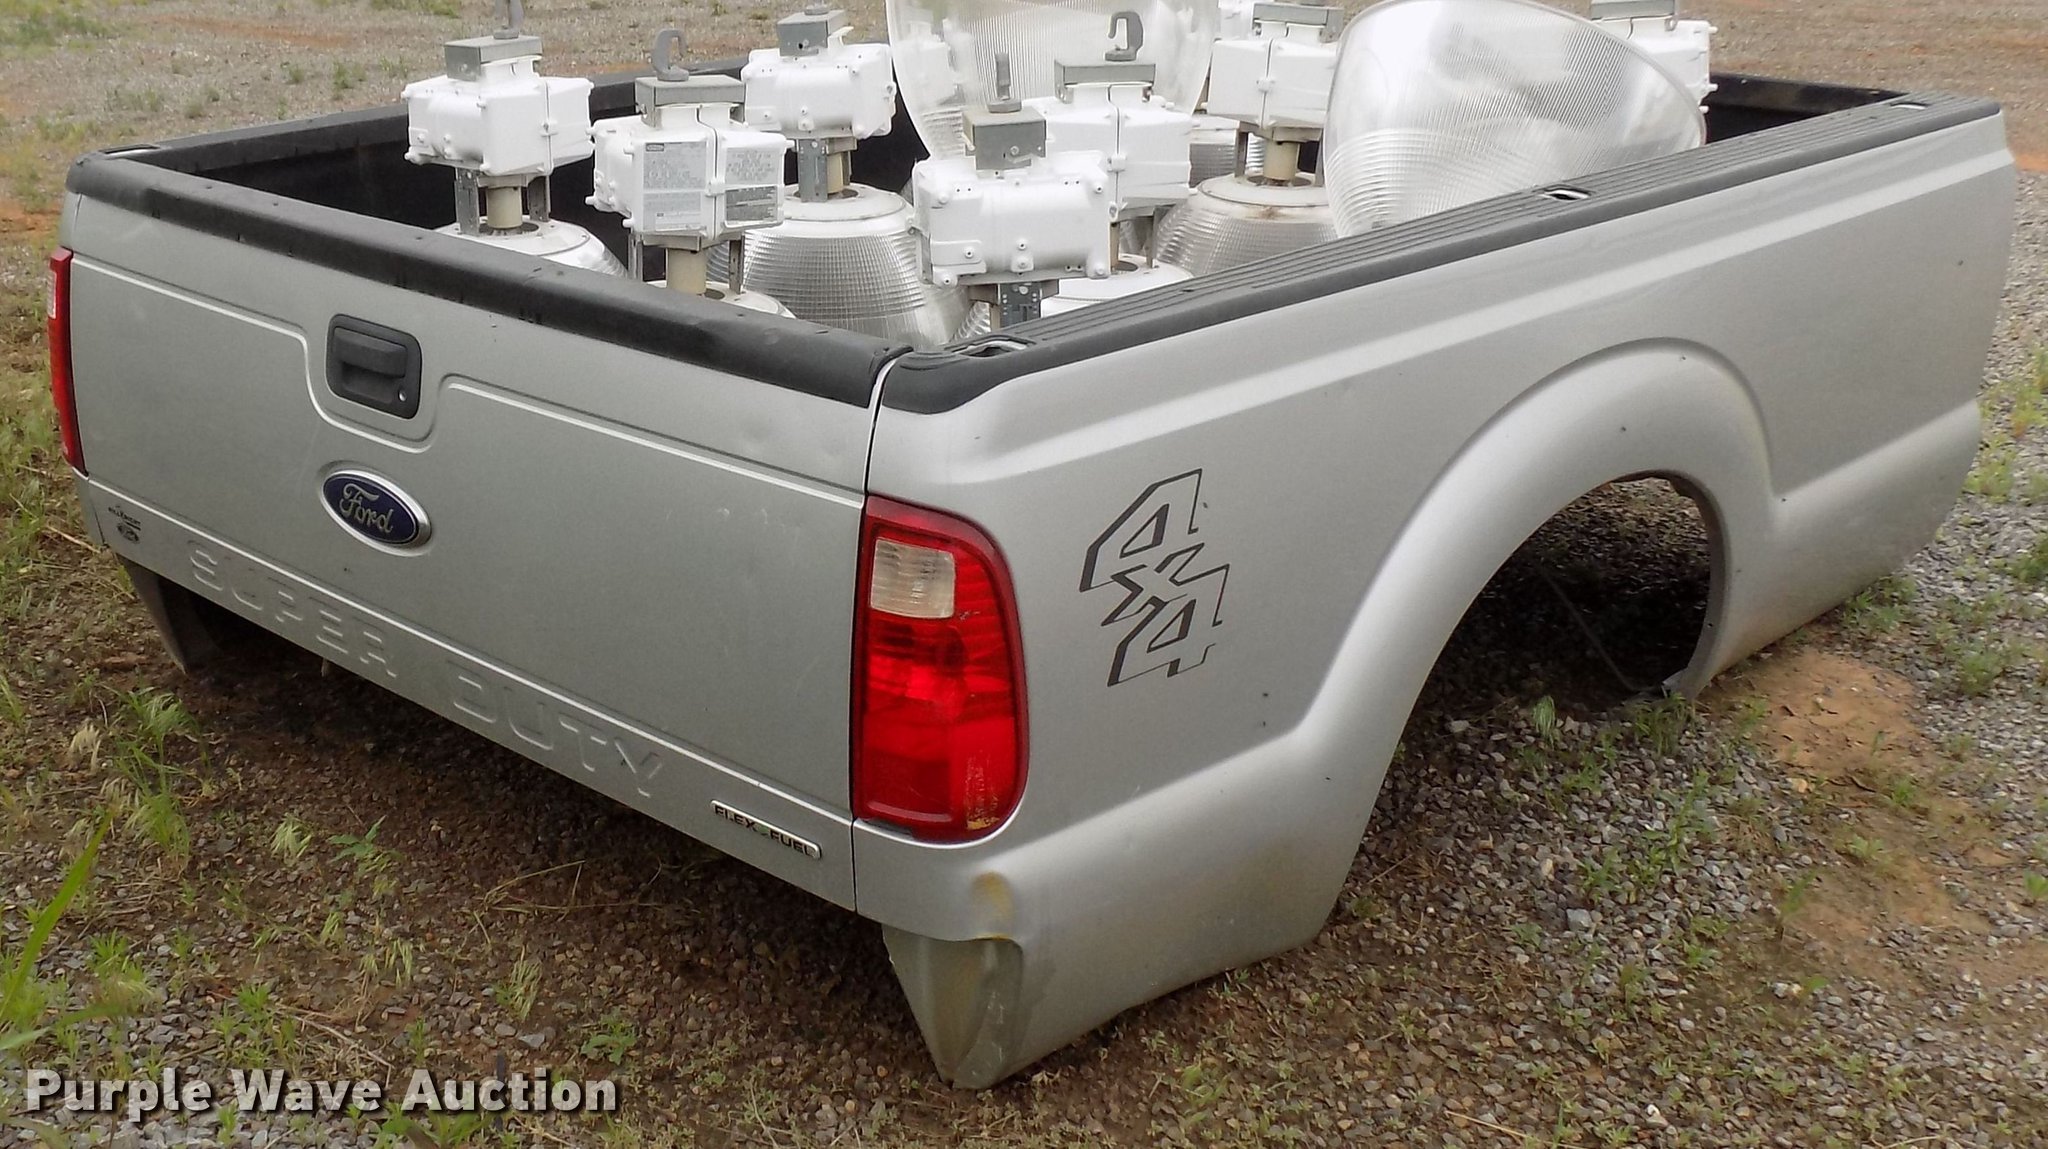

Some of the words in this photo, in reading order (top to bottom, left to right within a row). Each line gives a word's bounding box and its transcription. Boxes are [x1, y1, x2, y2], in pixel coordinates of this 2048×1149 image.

[339, 483, 394, 533] Ford
[187, 540, 398, 679] SUPER
[447, 660, 662, 798] DUTY
[714, 804, 758, 832] FLEX
[769, 828, 816, 858] FUEL
